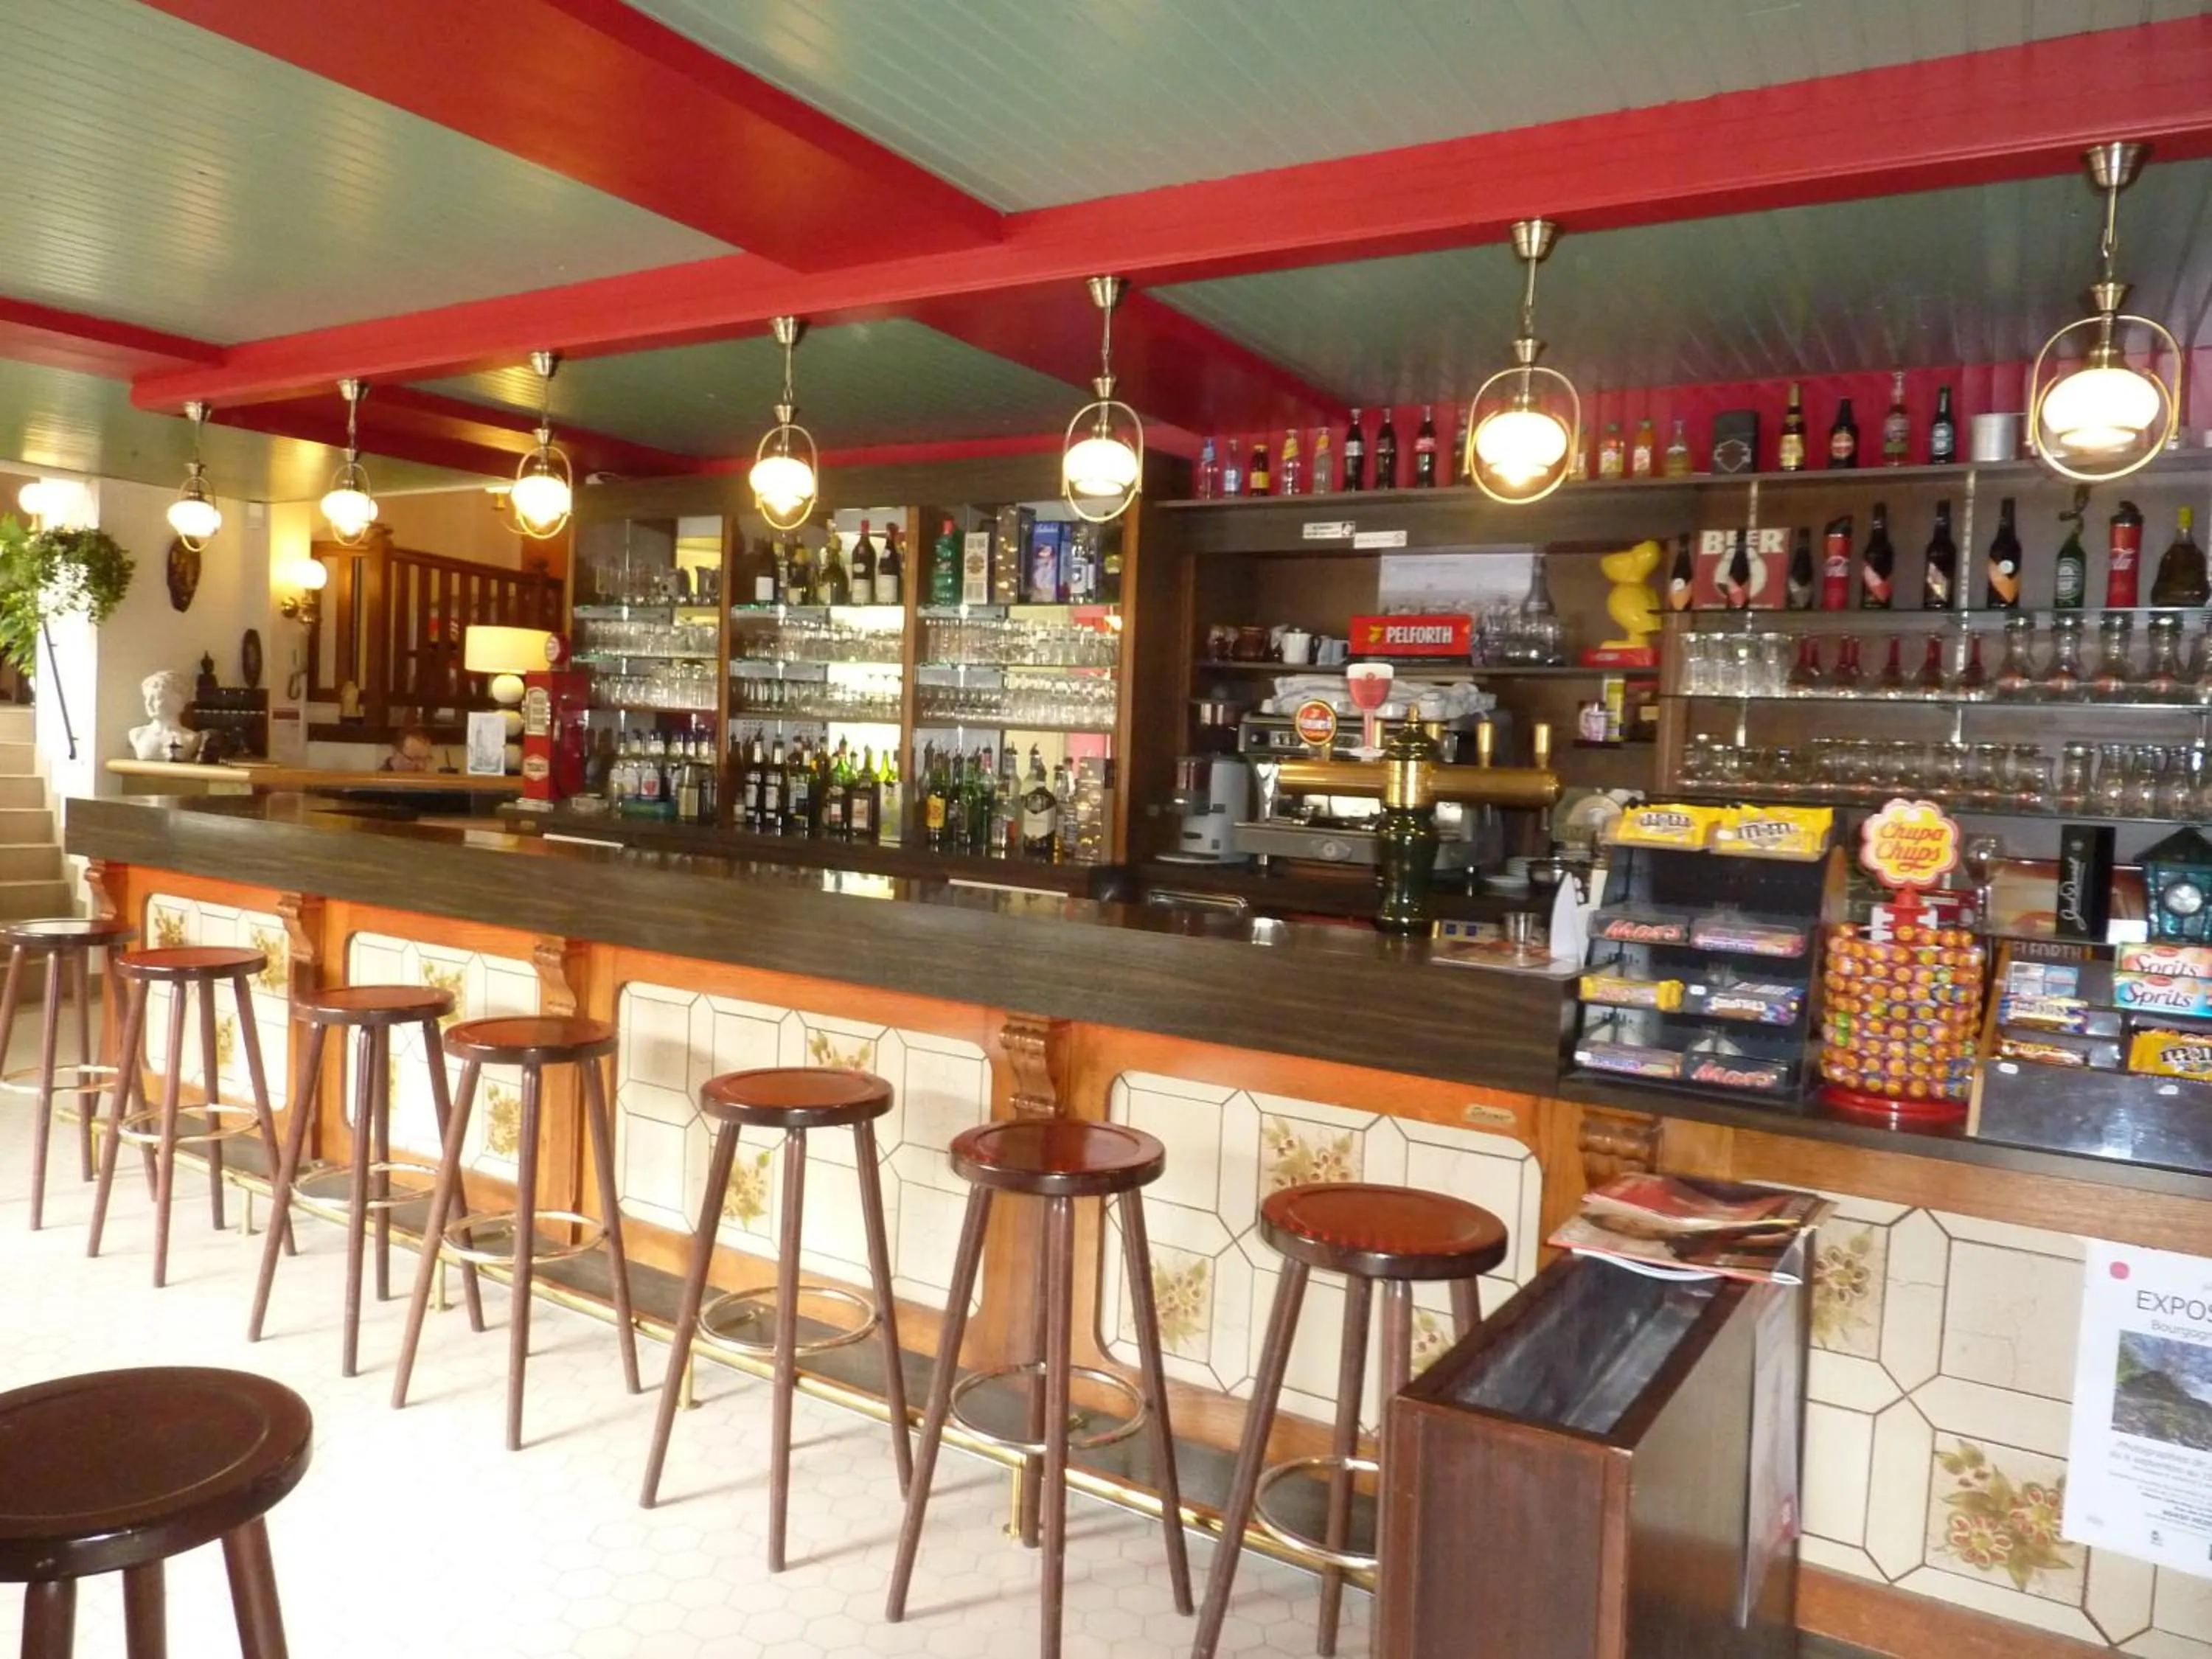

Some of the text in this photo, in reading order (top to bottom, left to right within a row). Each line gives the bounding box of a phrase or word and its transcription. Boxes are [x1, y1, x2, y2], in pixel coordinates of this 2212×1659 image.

[1386, 625, 1453, 644] PELFORTH
[1879, 821, 1947, 845] Chupa
[1875, 841, 1942, 867] Chups
[2119, 981, 2192, 1007] Sprits
